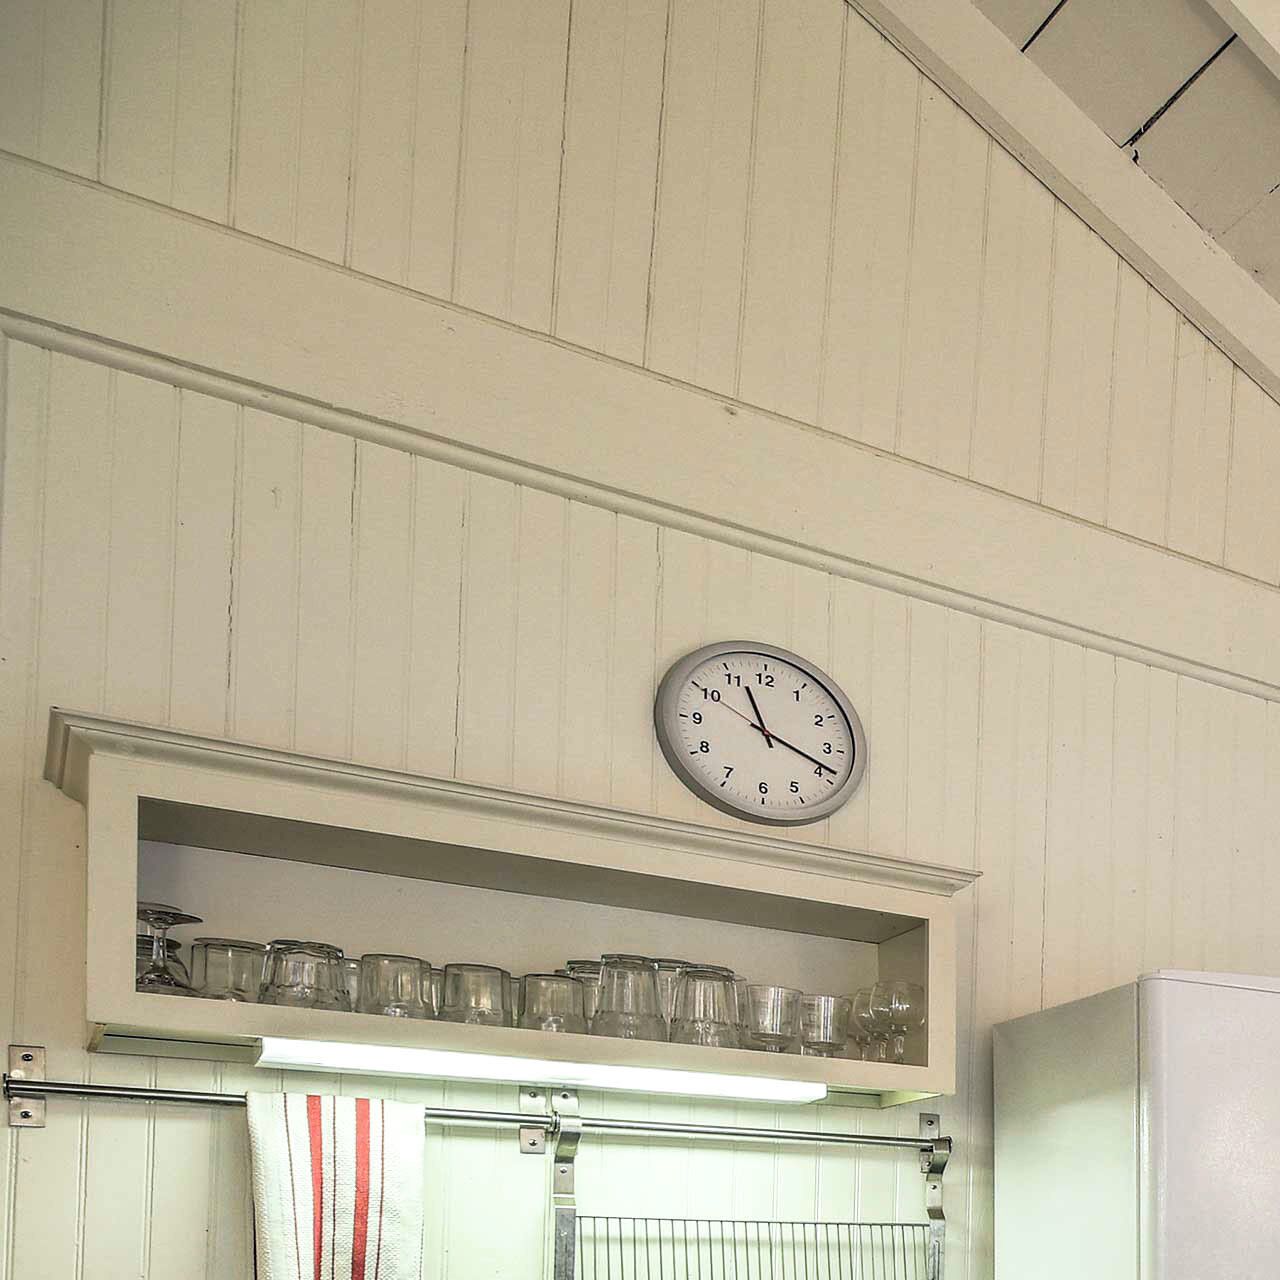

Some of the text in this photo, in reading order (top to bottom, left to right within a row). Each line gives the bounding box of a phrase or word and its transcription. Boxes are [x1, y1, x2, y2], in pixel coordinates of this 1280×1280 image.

[724, 672, 742, 687] 11
[755, 672, 775, 687] 12
[701, 687, 721, 702] 10
[793, 689, 800, 702] 1
[692, 712, 702, 725] 9
[814, 714, 824, 727] 2
[699, 740, 710, 753] 8
[822, 742, 832, 754] 3
[723, 766, 734, 778] 7
[813, 764, 823, 777] 4
[758, 782, 768, 794] 6
[789, 781, 799, 793] 5
